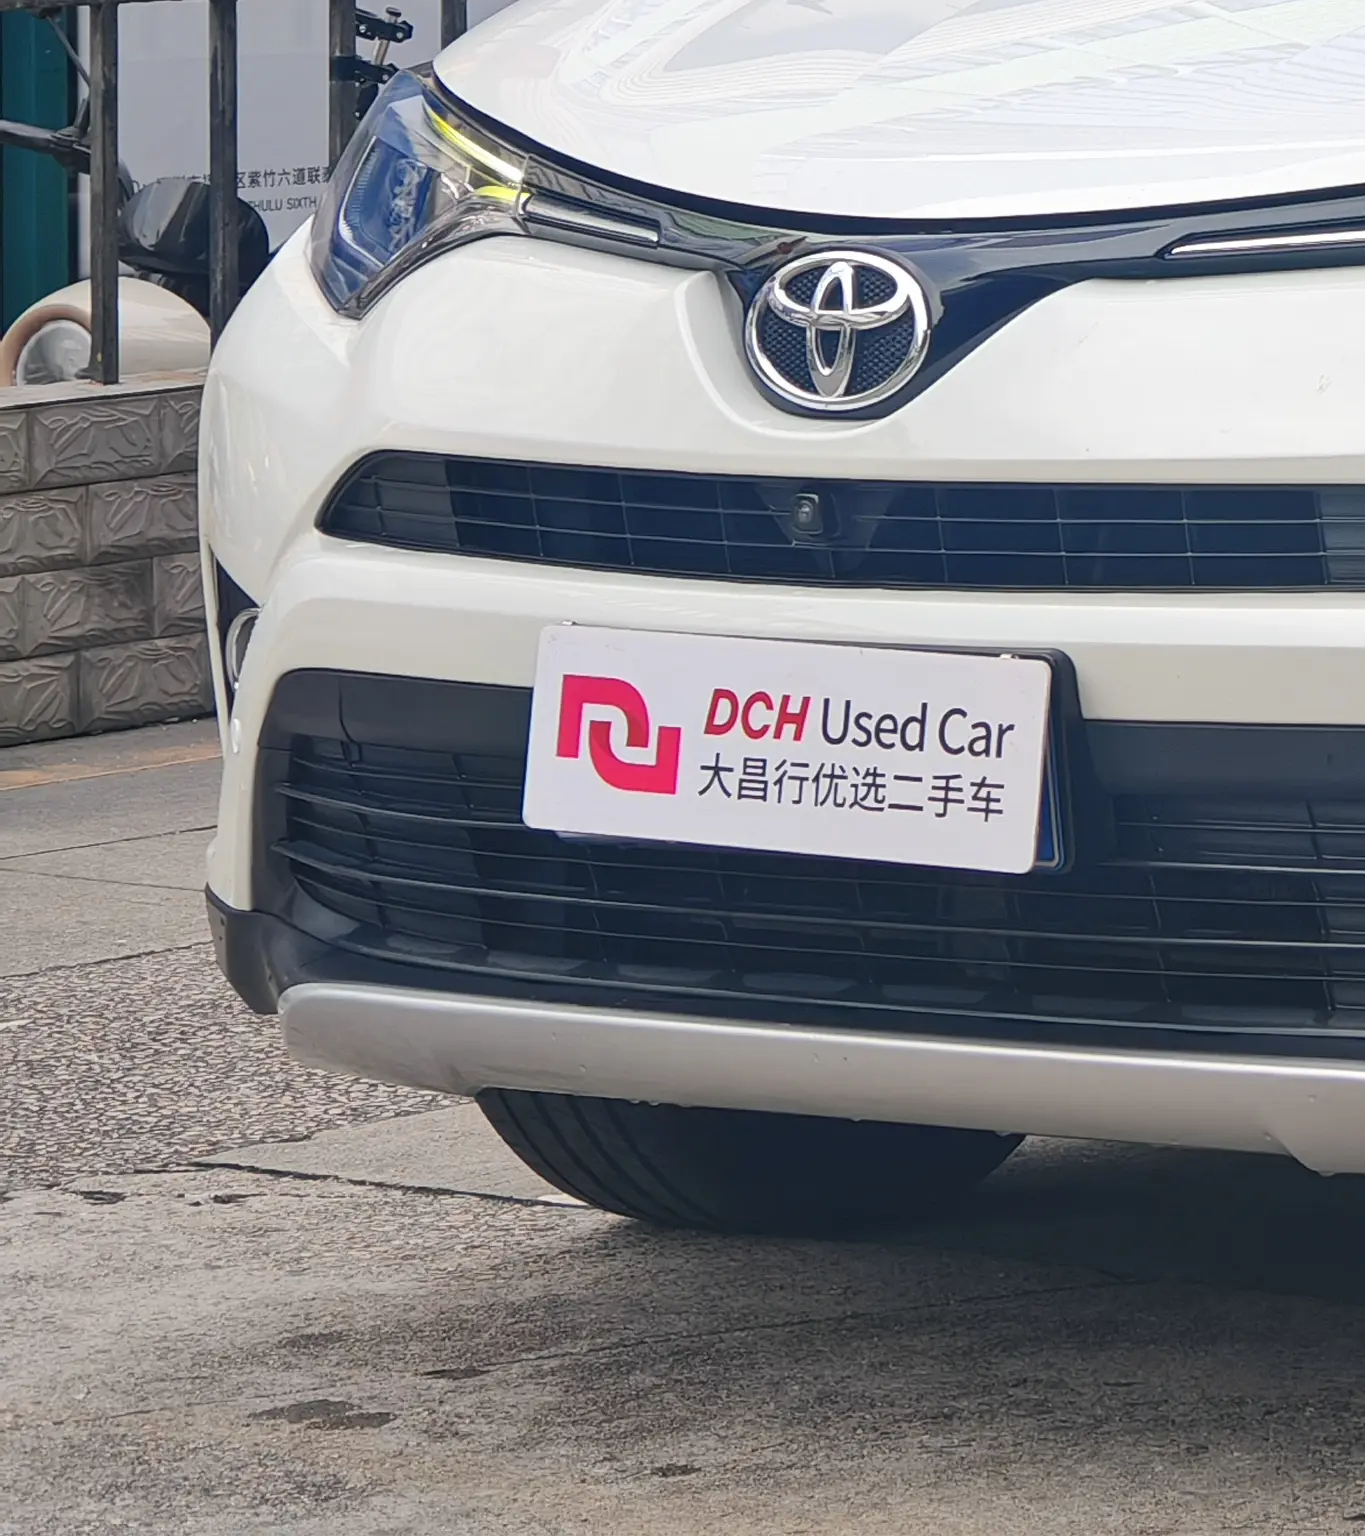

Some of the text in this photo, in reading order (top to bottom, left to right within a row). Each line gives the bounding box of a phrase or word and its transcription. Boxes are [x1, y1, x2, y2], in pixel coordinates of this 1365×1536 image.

[286, 196, 317, 211] SIXTH
[704, 688, 1016, 759] DCH Used Car
[698, 752, 1005, 823] 大昌行优选二手车
